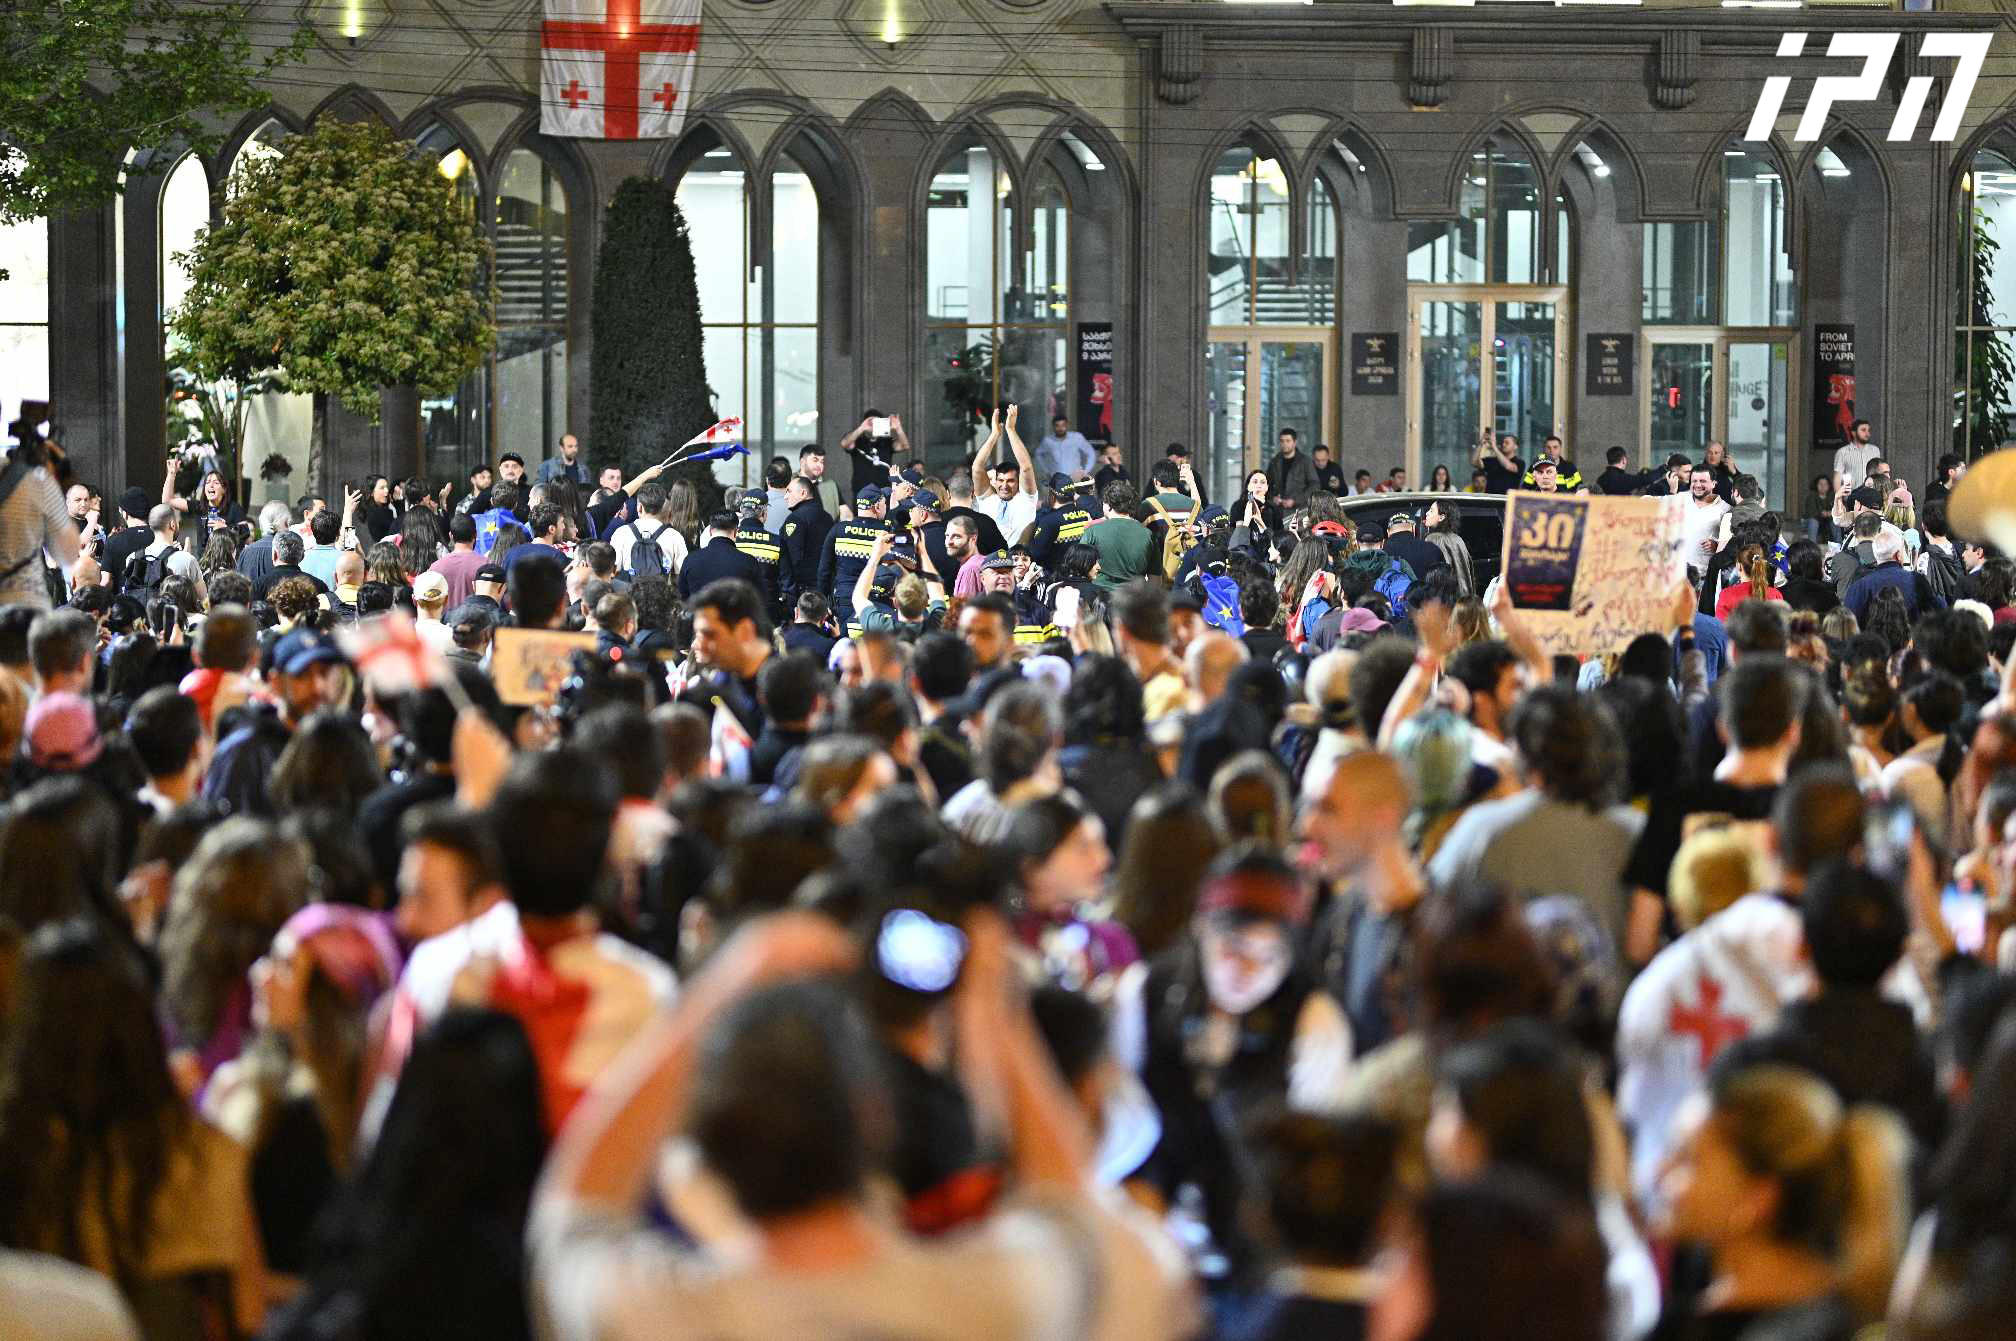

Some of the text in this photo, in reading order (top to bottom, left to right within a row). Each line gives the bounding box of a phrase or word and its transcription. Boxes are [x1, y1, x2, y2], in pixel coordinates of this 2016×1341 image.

[1820, 332, 1848, 342] FROM
[1820, 342, 1853, 352] SOVIET
[1820, 351, 1833, 361] TO
